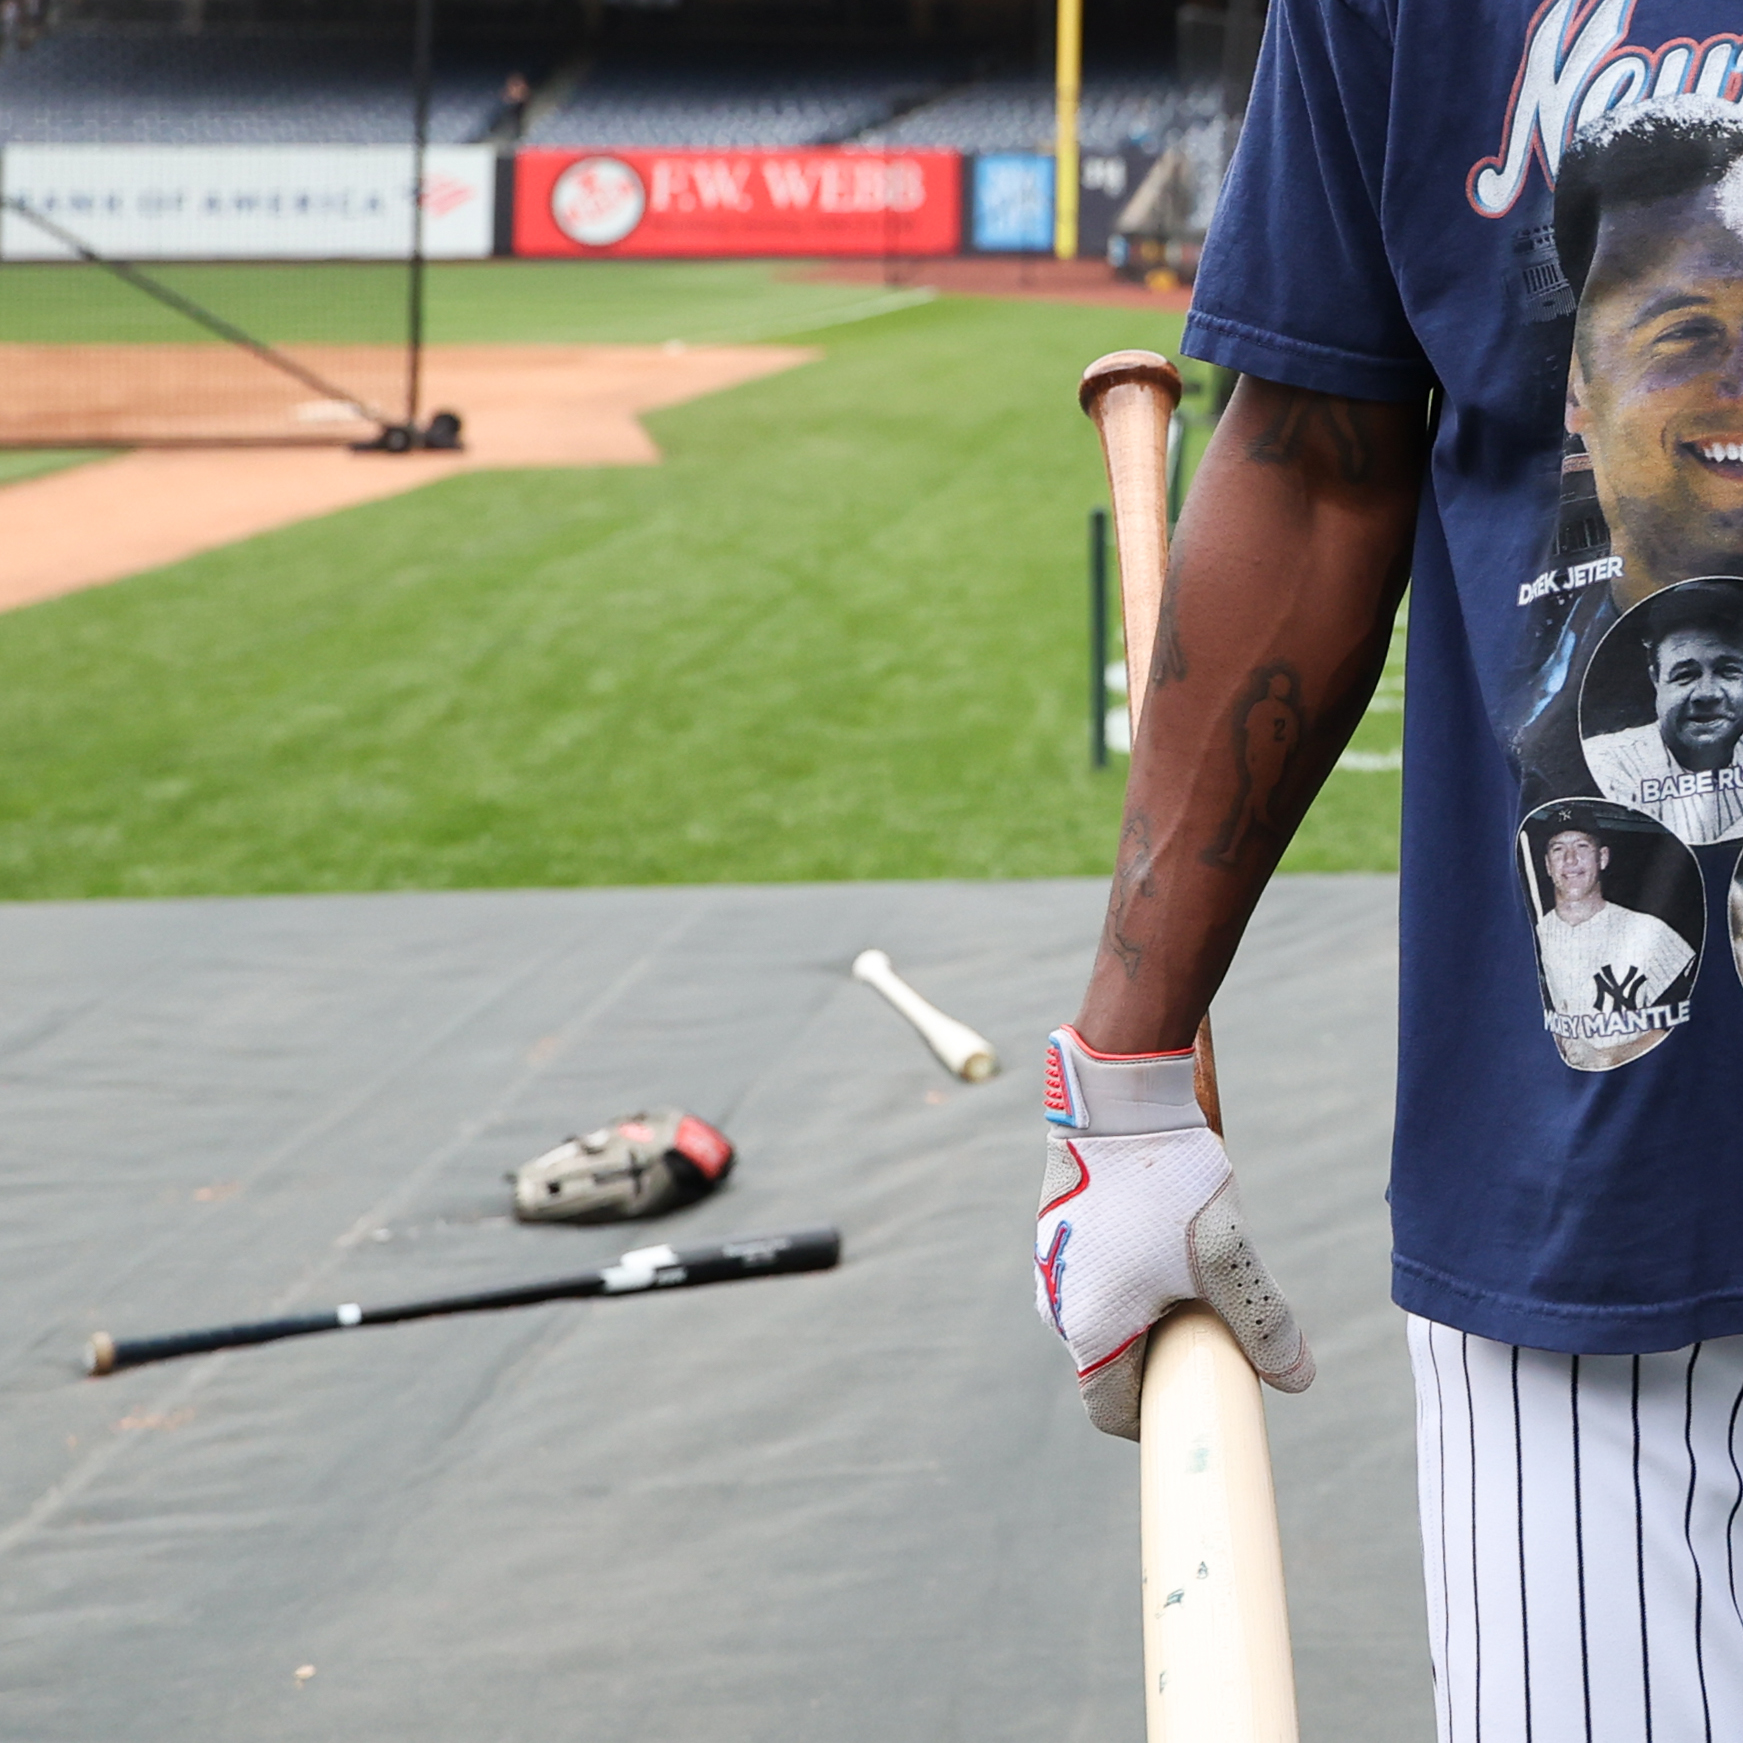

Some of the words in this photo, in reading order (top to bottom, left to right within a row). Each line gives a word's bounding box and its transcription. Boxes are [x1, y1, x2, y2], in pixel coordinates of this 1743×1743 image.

[1562, 556, 1625, 590] JETER
[1641, 770, 1715, 804] BABE
[1580, 999, 1691, 1040] MANTLE
